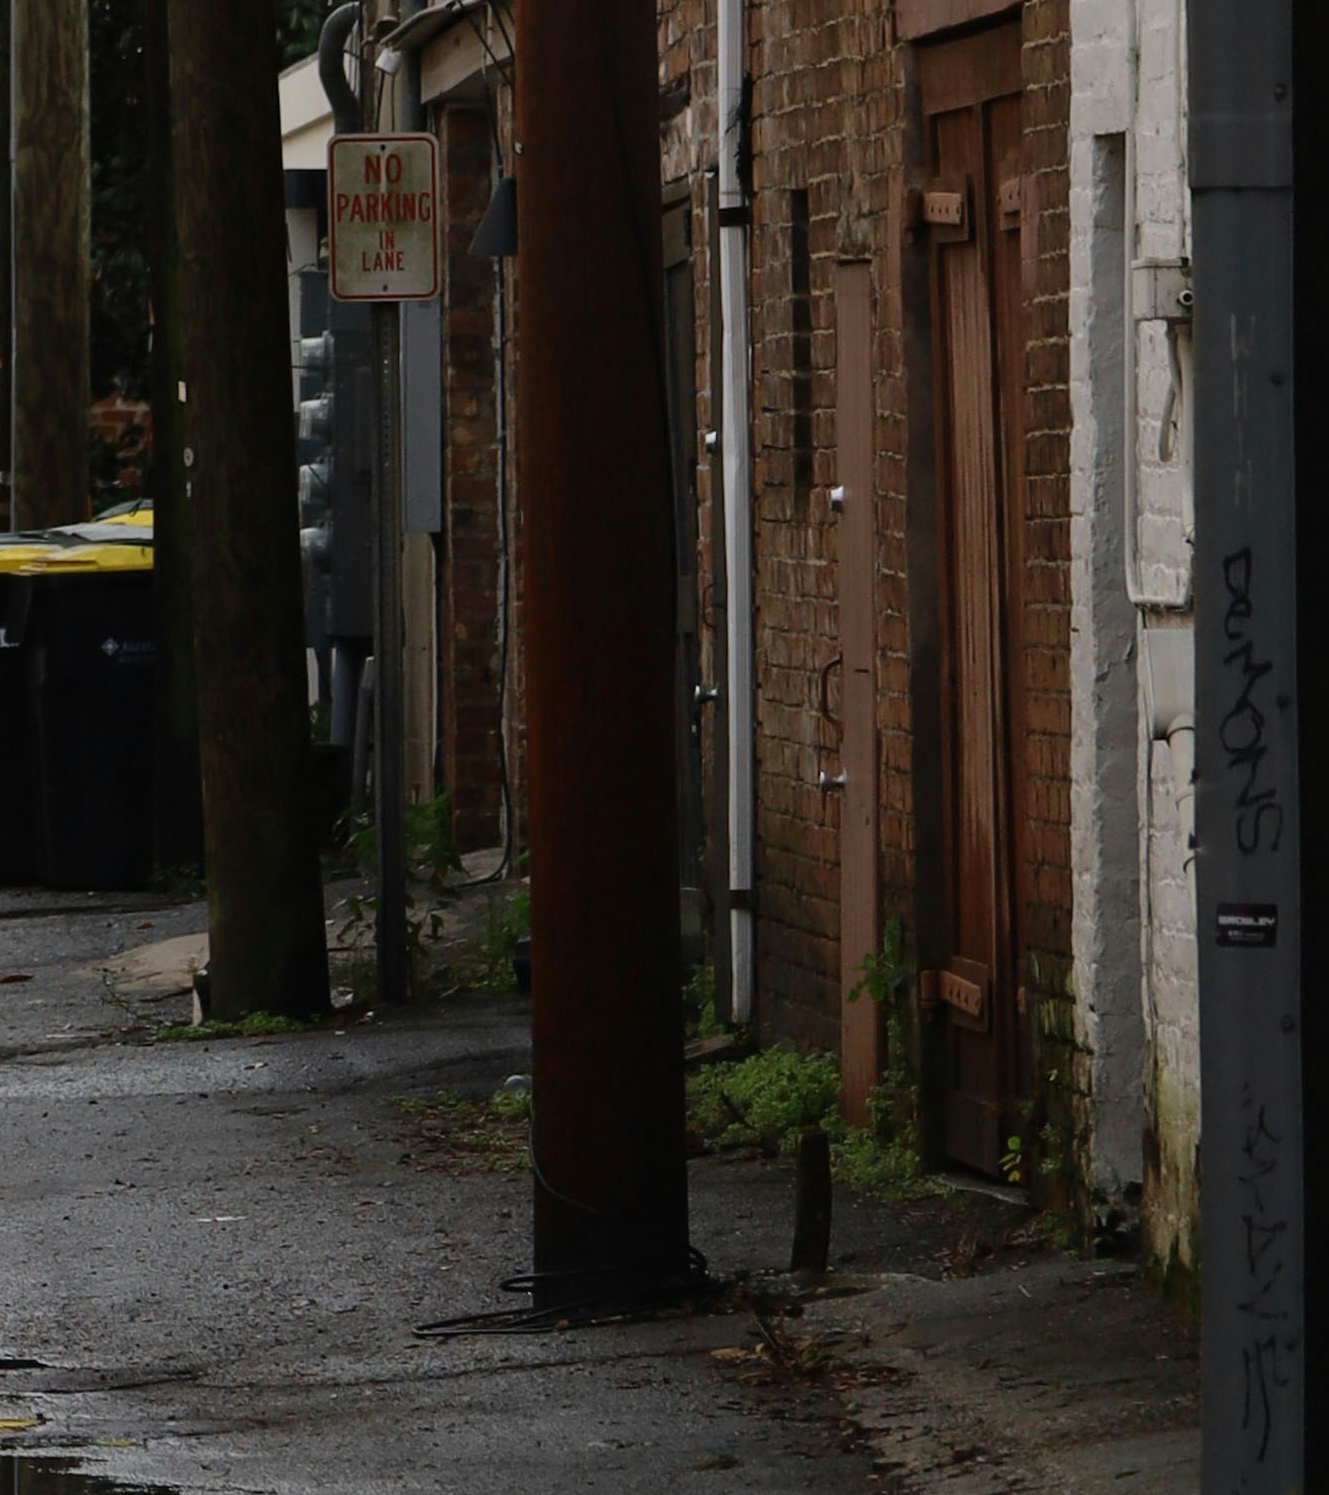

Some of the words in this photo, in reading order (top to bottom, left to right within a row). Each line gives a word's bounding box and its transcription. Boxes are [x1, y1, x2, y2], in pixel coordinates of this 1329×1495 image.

[364, 153, 403, 184] NO
[336, 191, 432, 223] PARKING
[379, 230, 395, 250] IN
[362, 250, 405, 272] LANE
